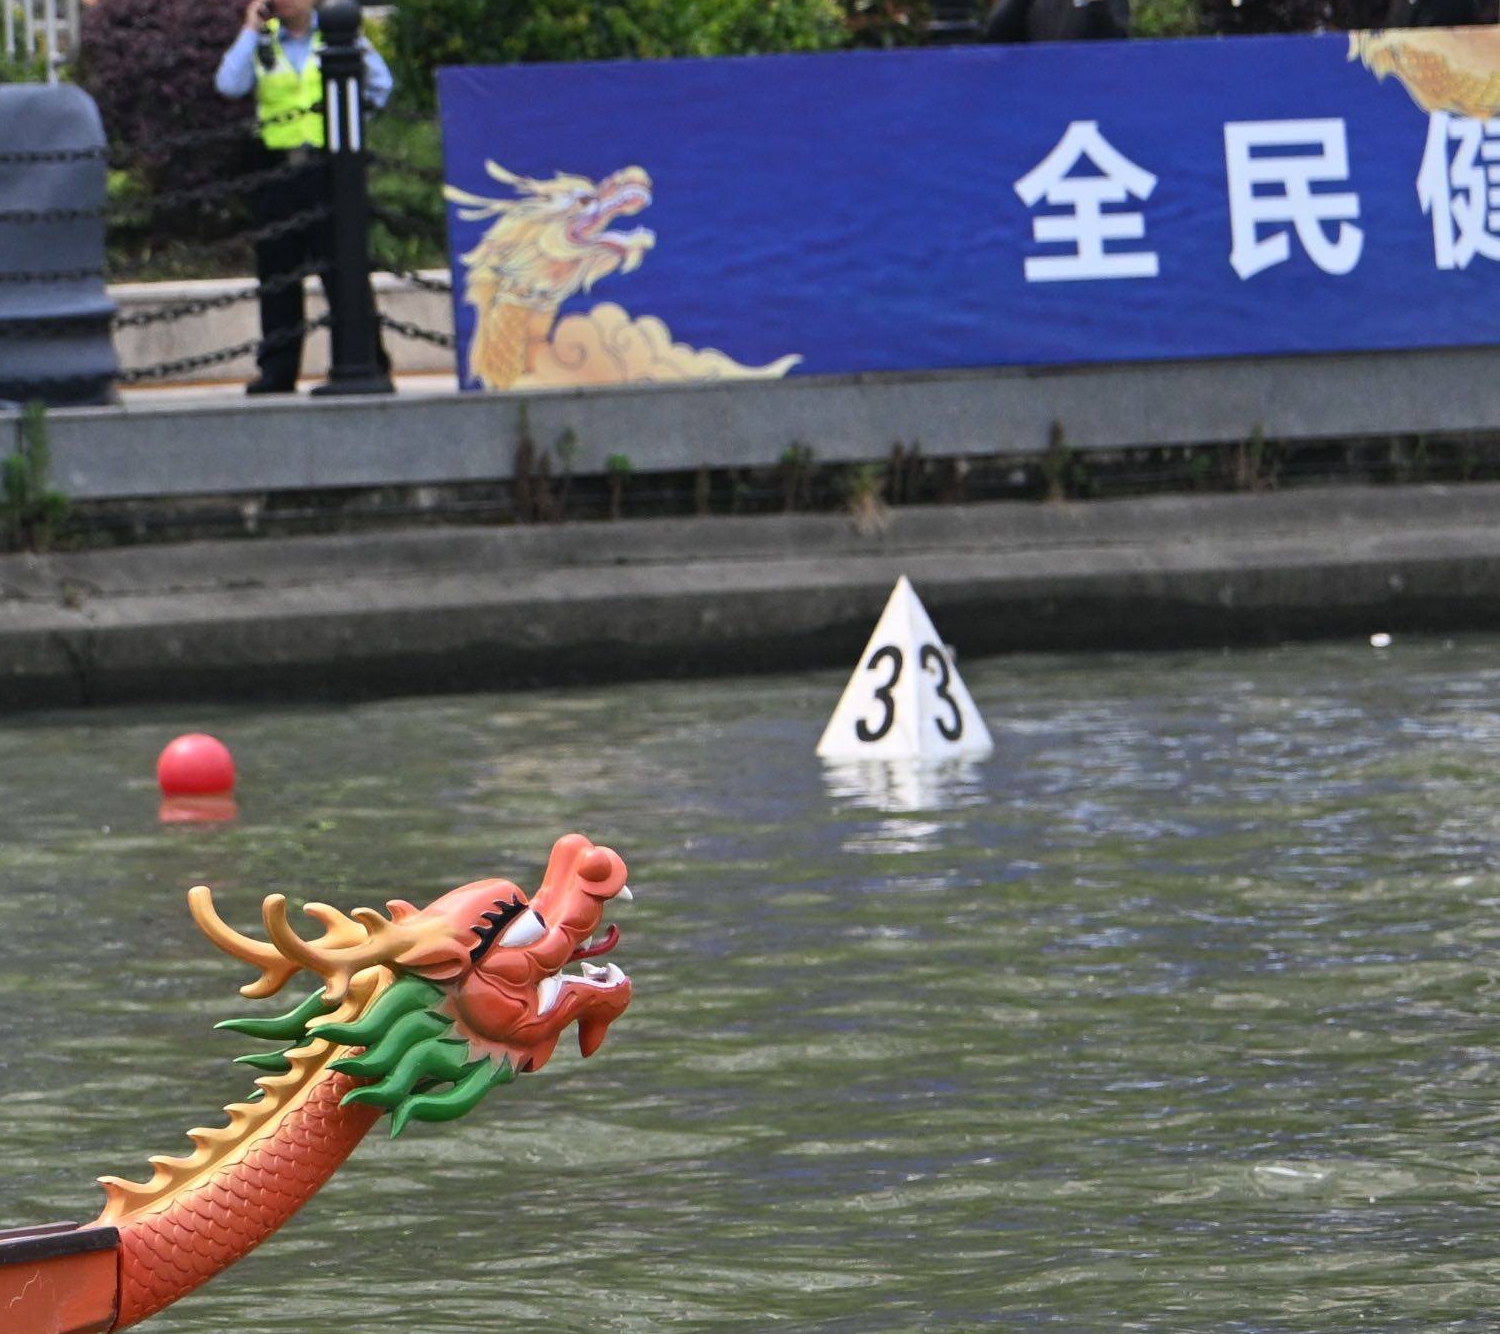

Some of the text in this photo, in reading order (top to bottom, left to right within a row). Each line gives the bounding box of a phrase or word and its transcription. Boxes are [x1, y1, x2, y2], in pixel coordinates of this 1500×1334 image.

[1013, 110, 1500, 282] 全民健
[856, 645, 903, 742] 3
[920, 644, 962, 741] 3
